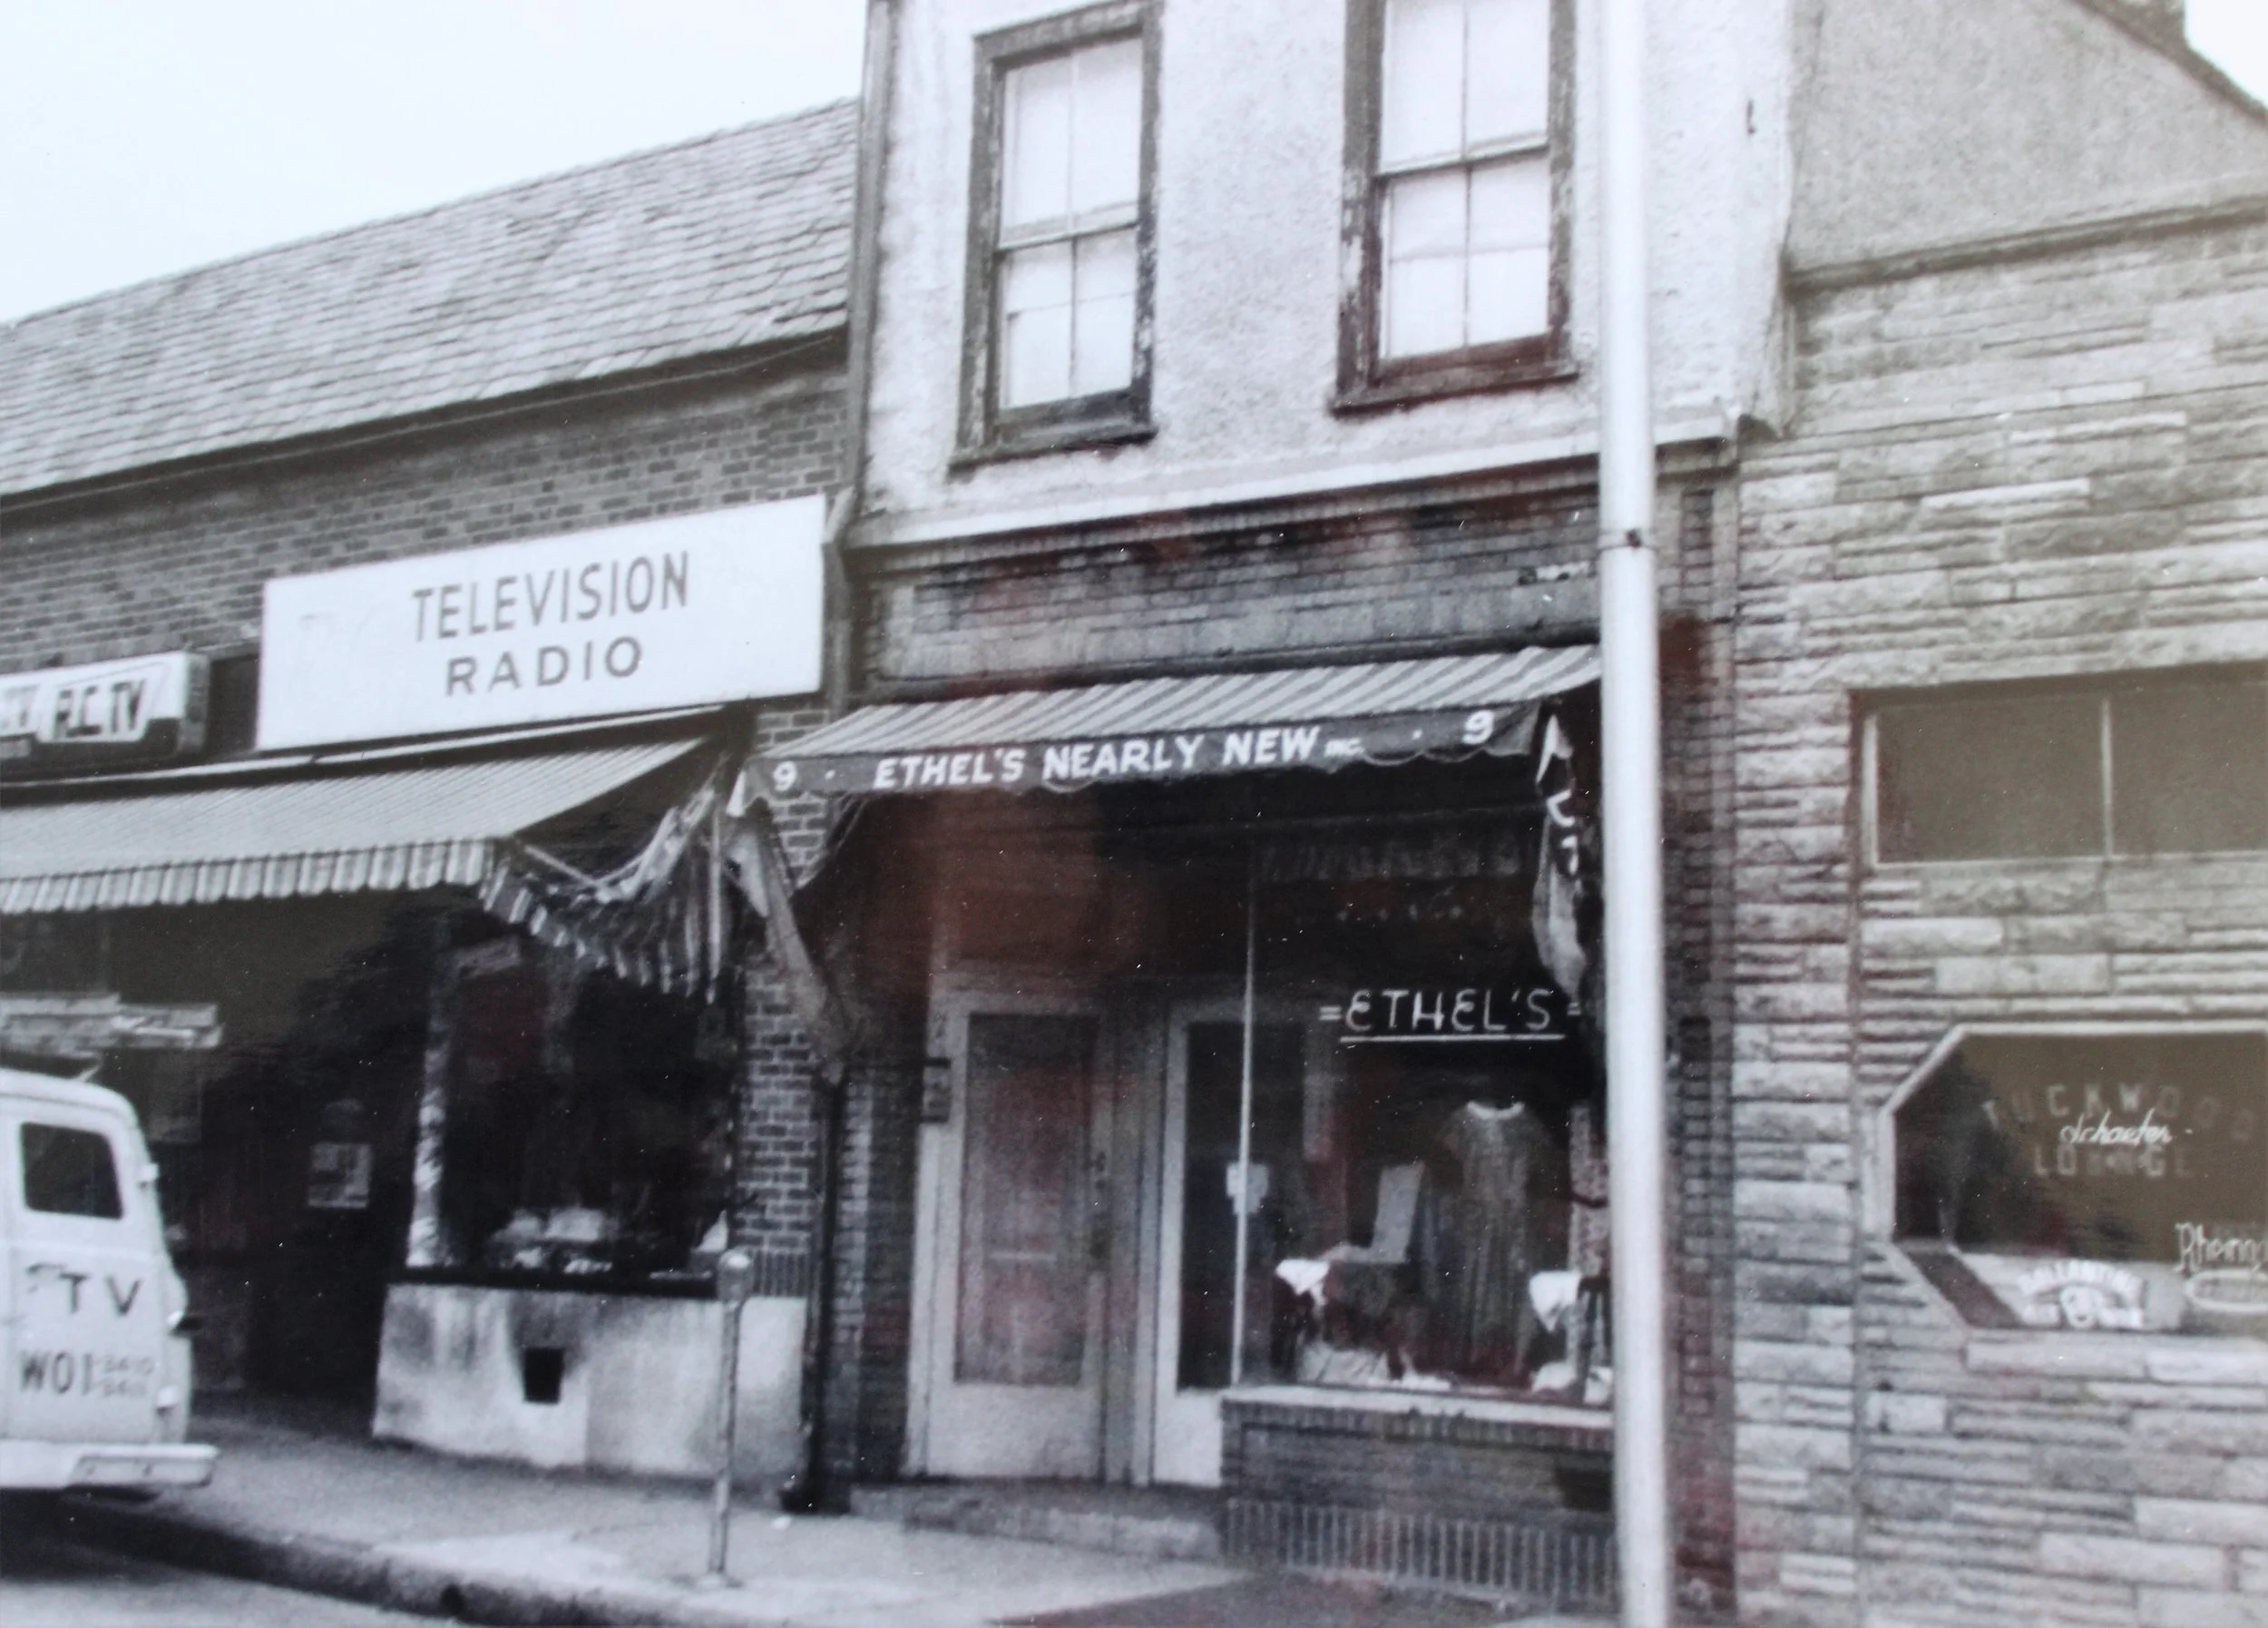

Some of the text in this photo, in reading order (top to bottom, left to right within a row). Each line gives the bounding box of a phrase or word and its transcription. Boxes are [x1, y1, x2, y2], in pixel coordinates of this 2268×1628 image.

[412, 550, 688, 642] TELEVISION
[445, 635, 642, 697] RADIO
[772, 760, 798, 792] 9
[873, 747, 1027, 789] ETHEL'S
[1041, 733, 1206, 780] NEARLY
[1221, 725, 1321, 766] NEW
[1462, 709, 1495, 745] 9
[1345, 987, 1554, 1033] ETHEL'S
[57, 1273, 143, 1317] TV
